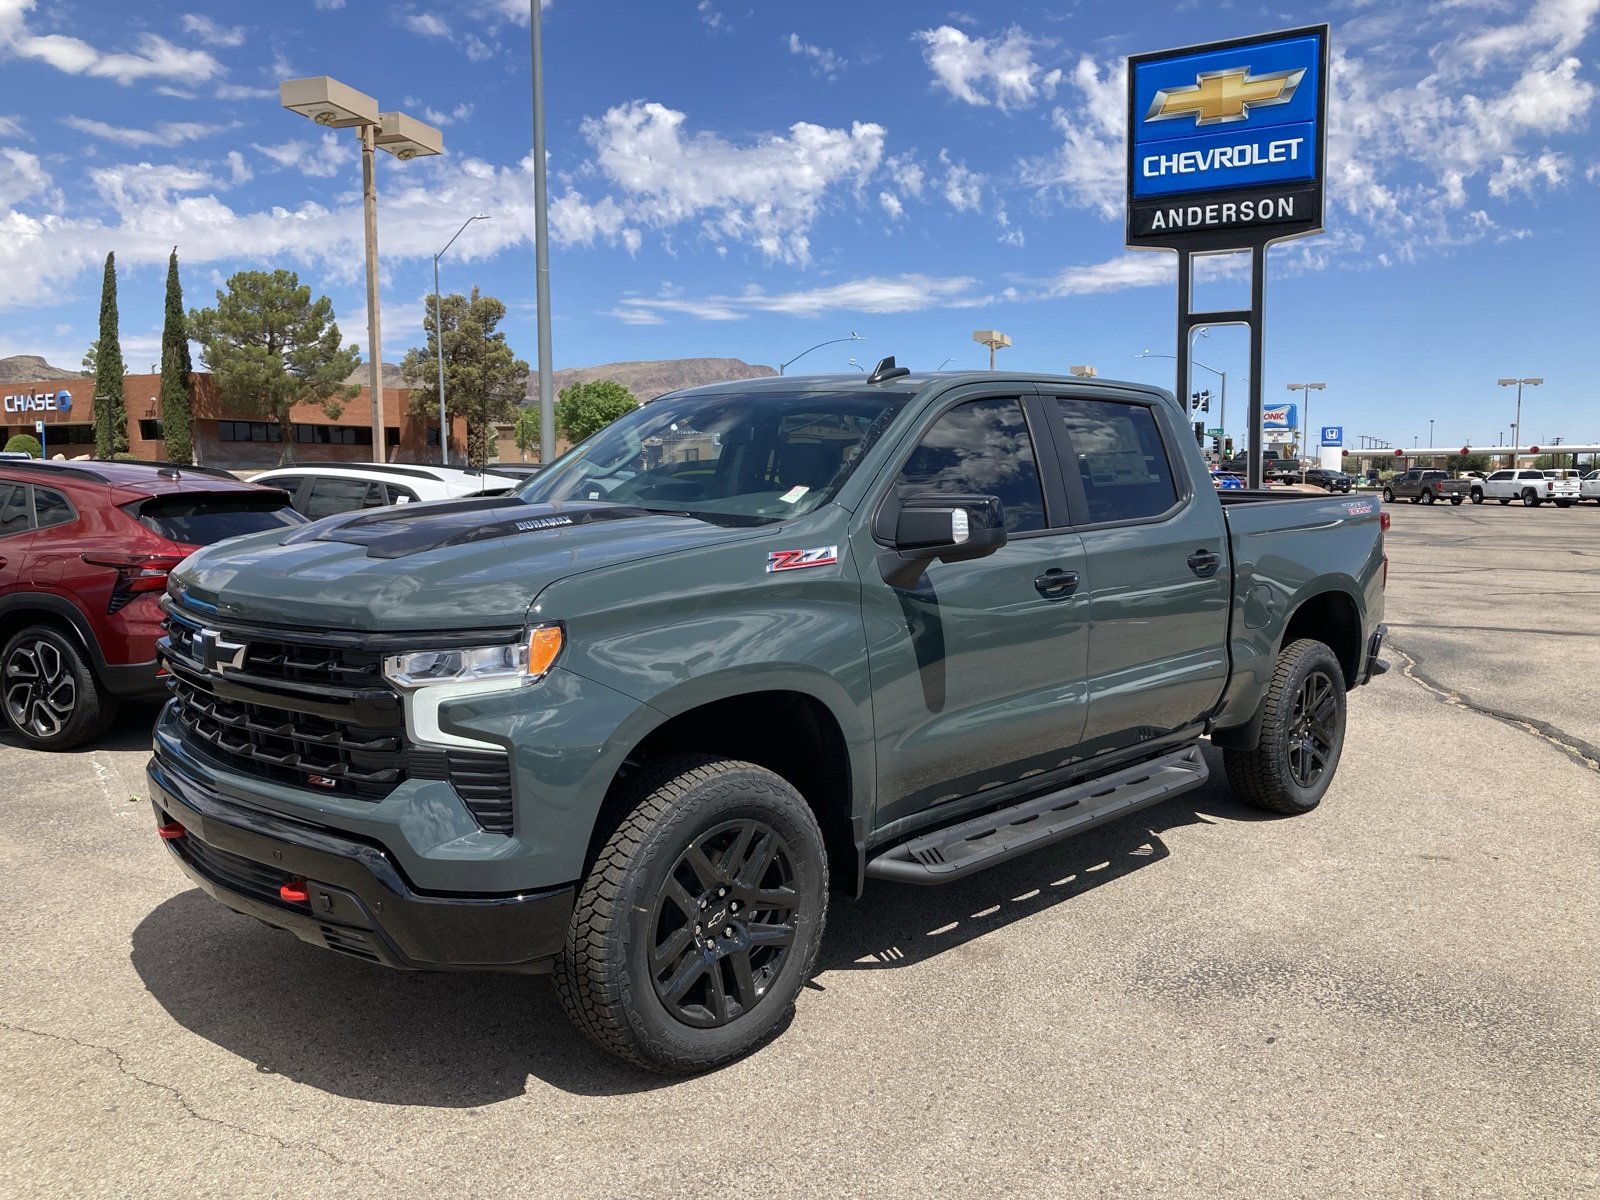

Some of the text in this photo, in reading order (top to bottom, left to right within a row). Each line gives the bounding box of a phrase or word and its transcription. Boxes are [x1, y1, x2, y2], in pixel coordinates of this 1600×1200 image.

[1143, 137, 1303, 177] CHEVROLET
[1151, 196, 1294, 230] ANDERSON
[4, 393, 58, 413] CHASE
[1263, 412, 1284, 420] ONIC
[515, 516, 573, 531] DURAMAX
[766, 545, 838, 573] Z71
